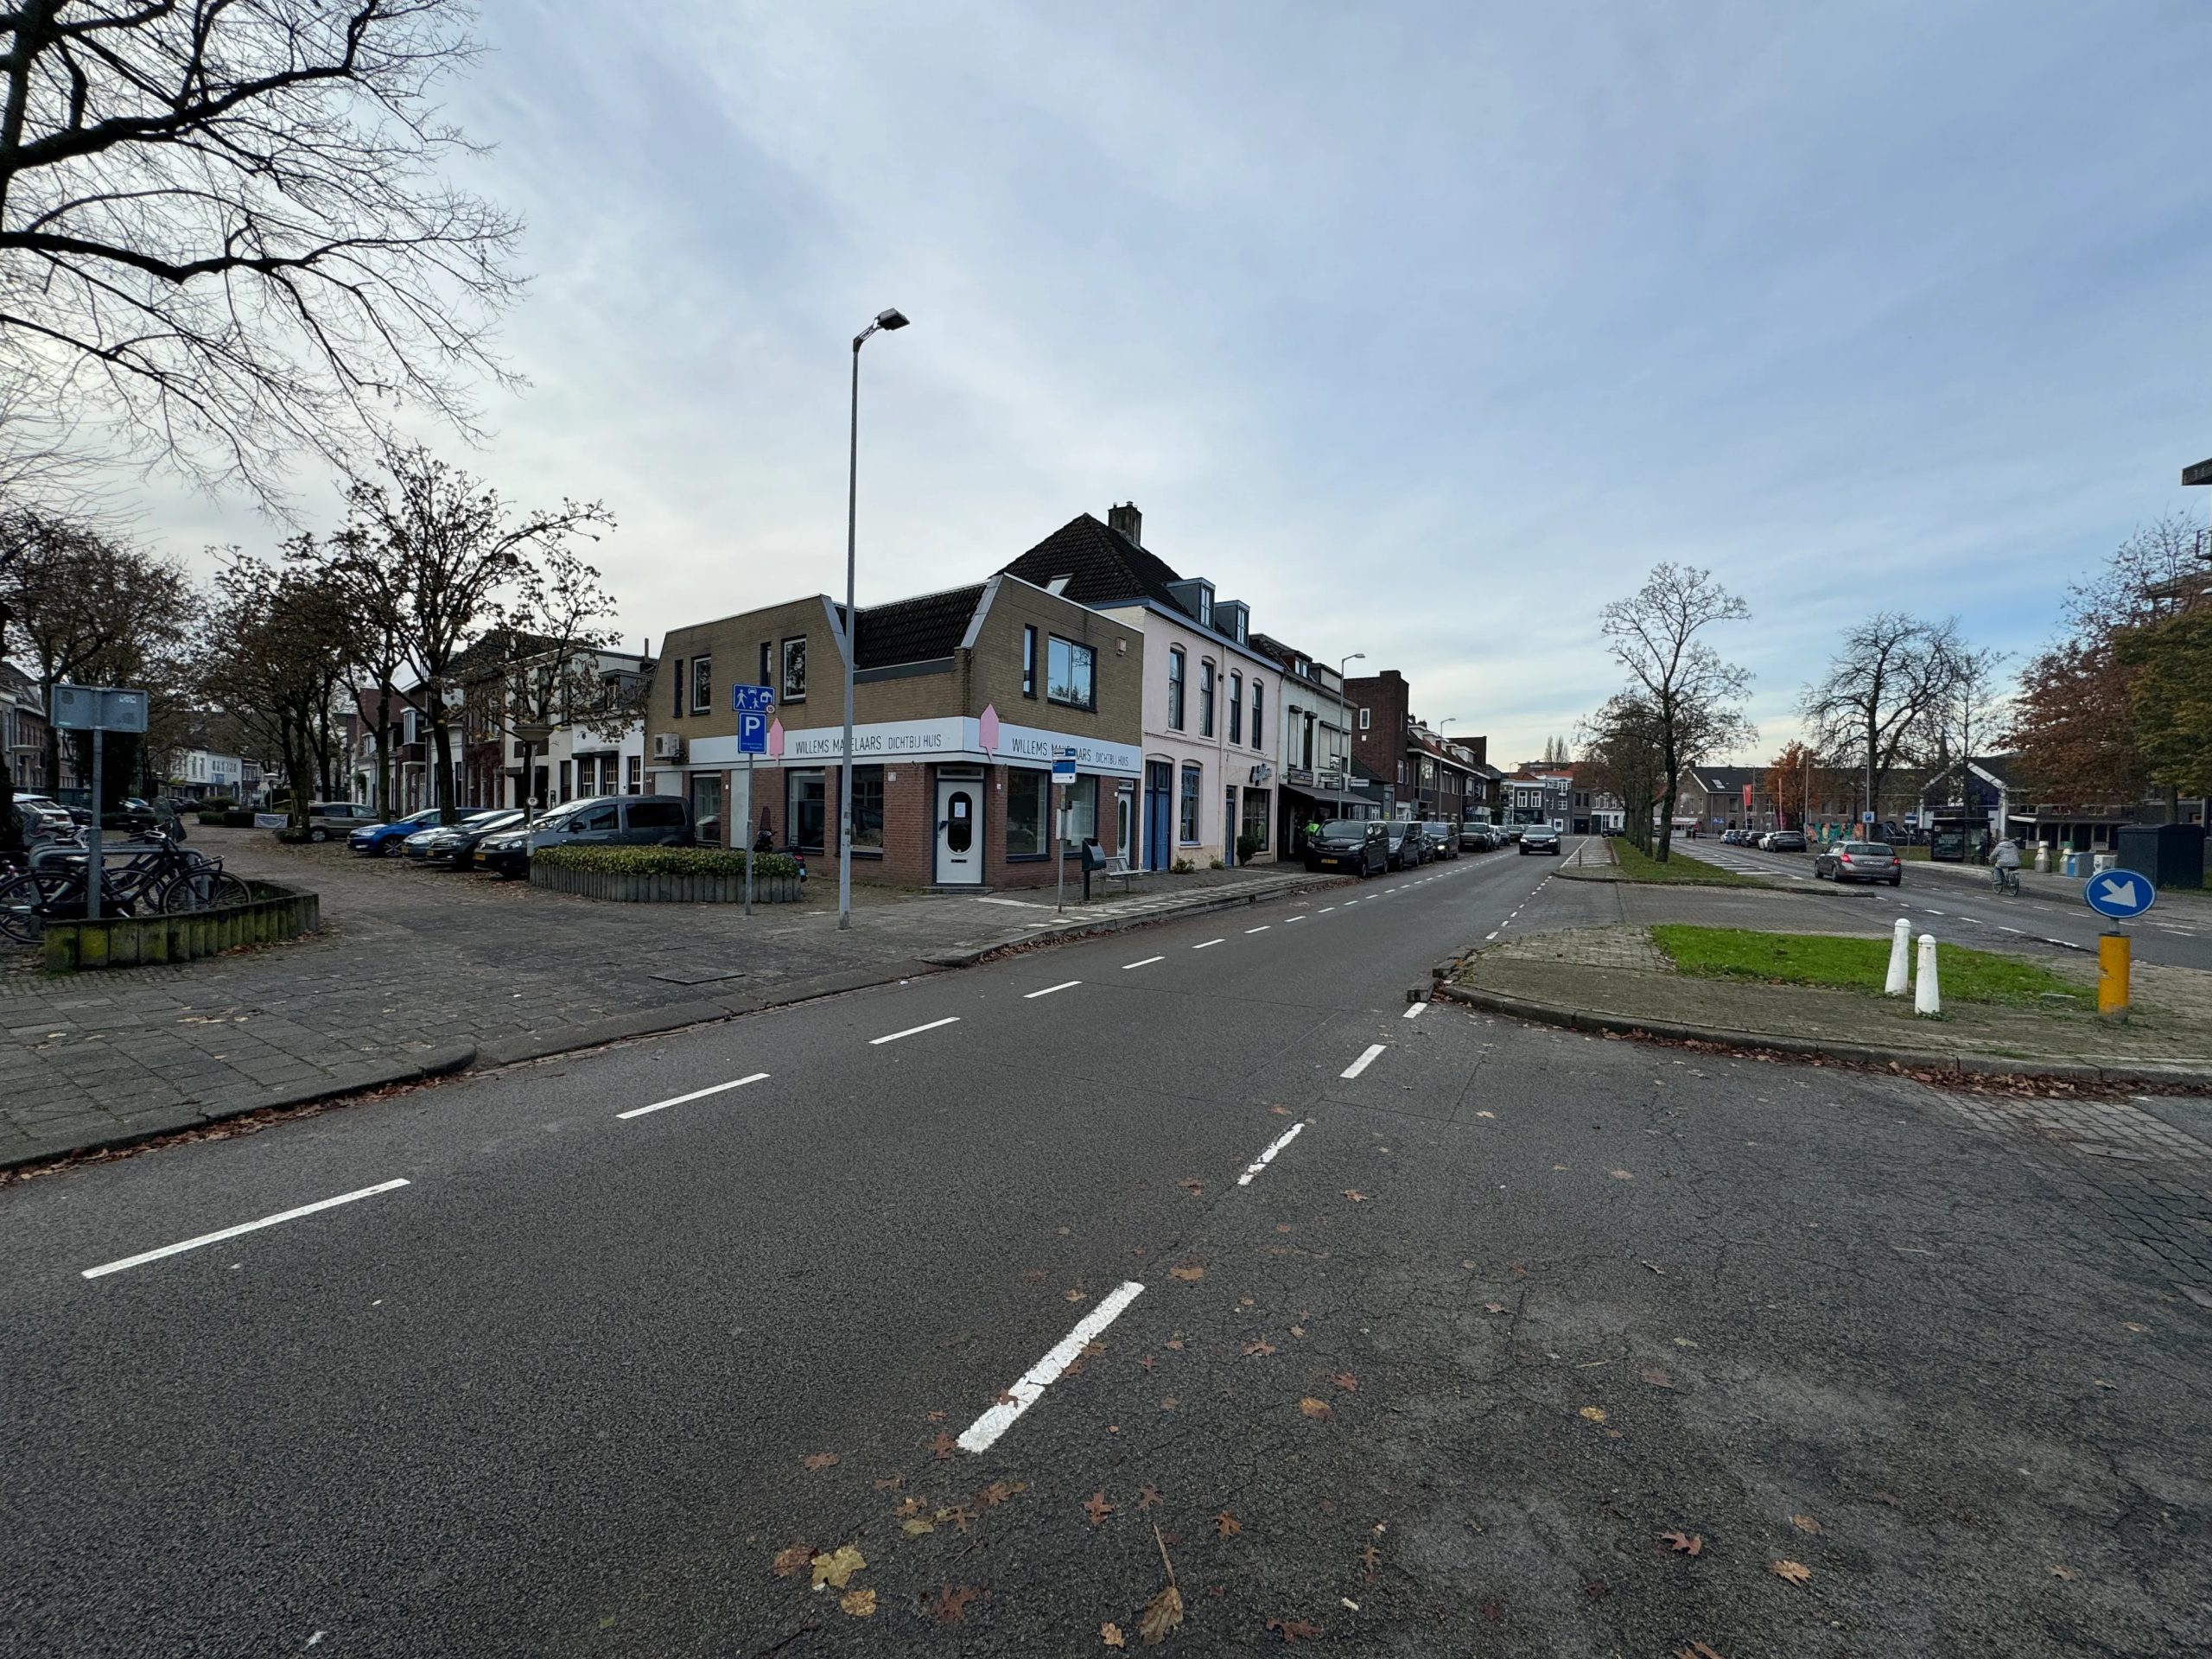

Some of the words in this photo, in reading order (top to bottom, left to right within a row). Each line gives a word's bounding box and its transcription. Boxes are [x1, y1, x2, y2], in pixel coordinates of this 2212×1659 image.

[745, 716, 760, 736] P
[796, 740, 830, 754] WILLEMS
[833, 736, 881, 753] MAELAARS
[888, 735, 921, 750] DICHTBIJ
[924, 734, 942, 747] HUIS
[1012, 738, 1047, 756] WILLEMS
[1096, 752, 1116, 766] DICHTBIJ
[1117, 756, 1128, 766] HUIS
